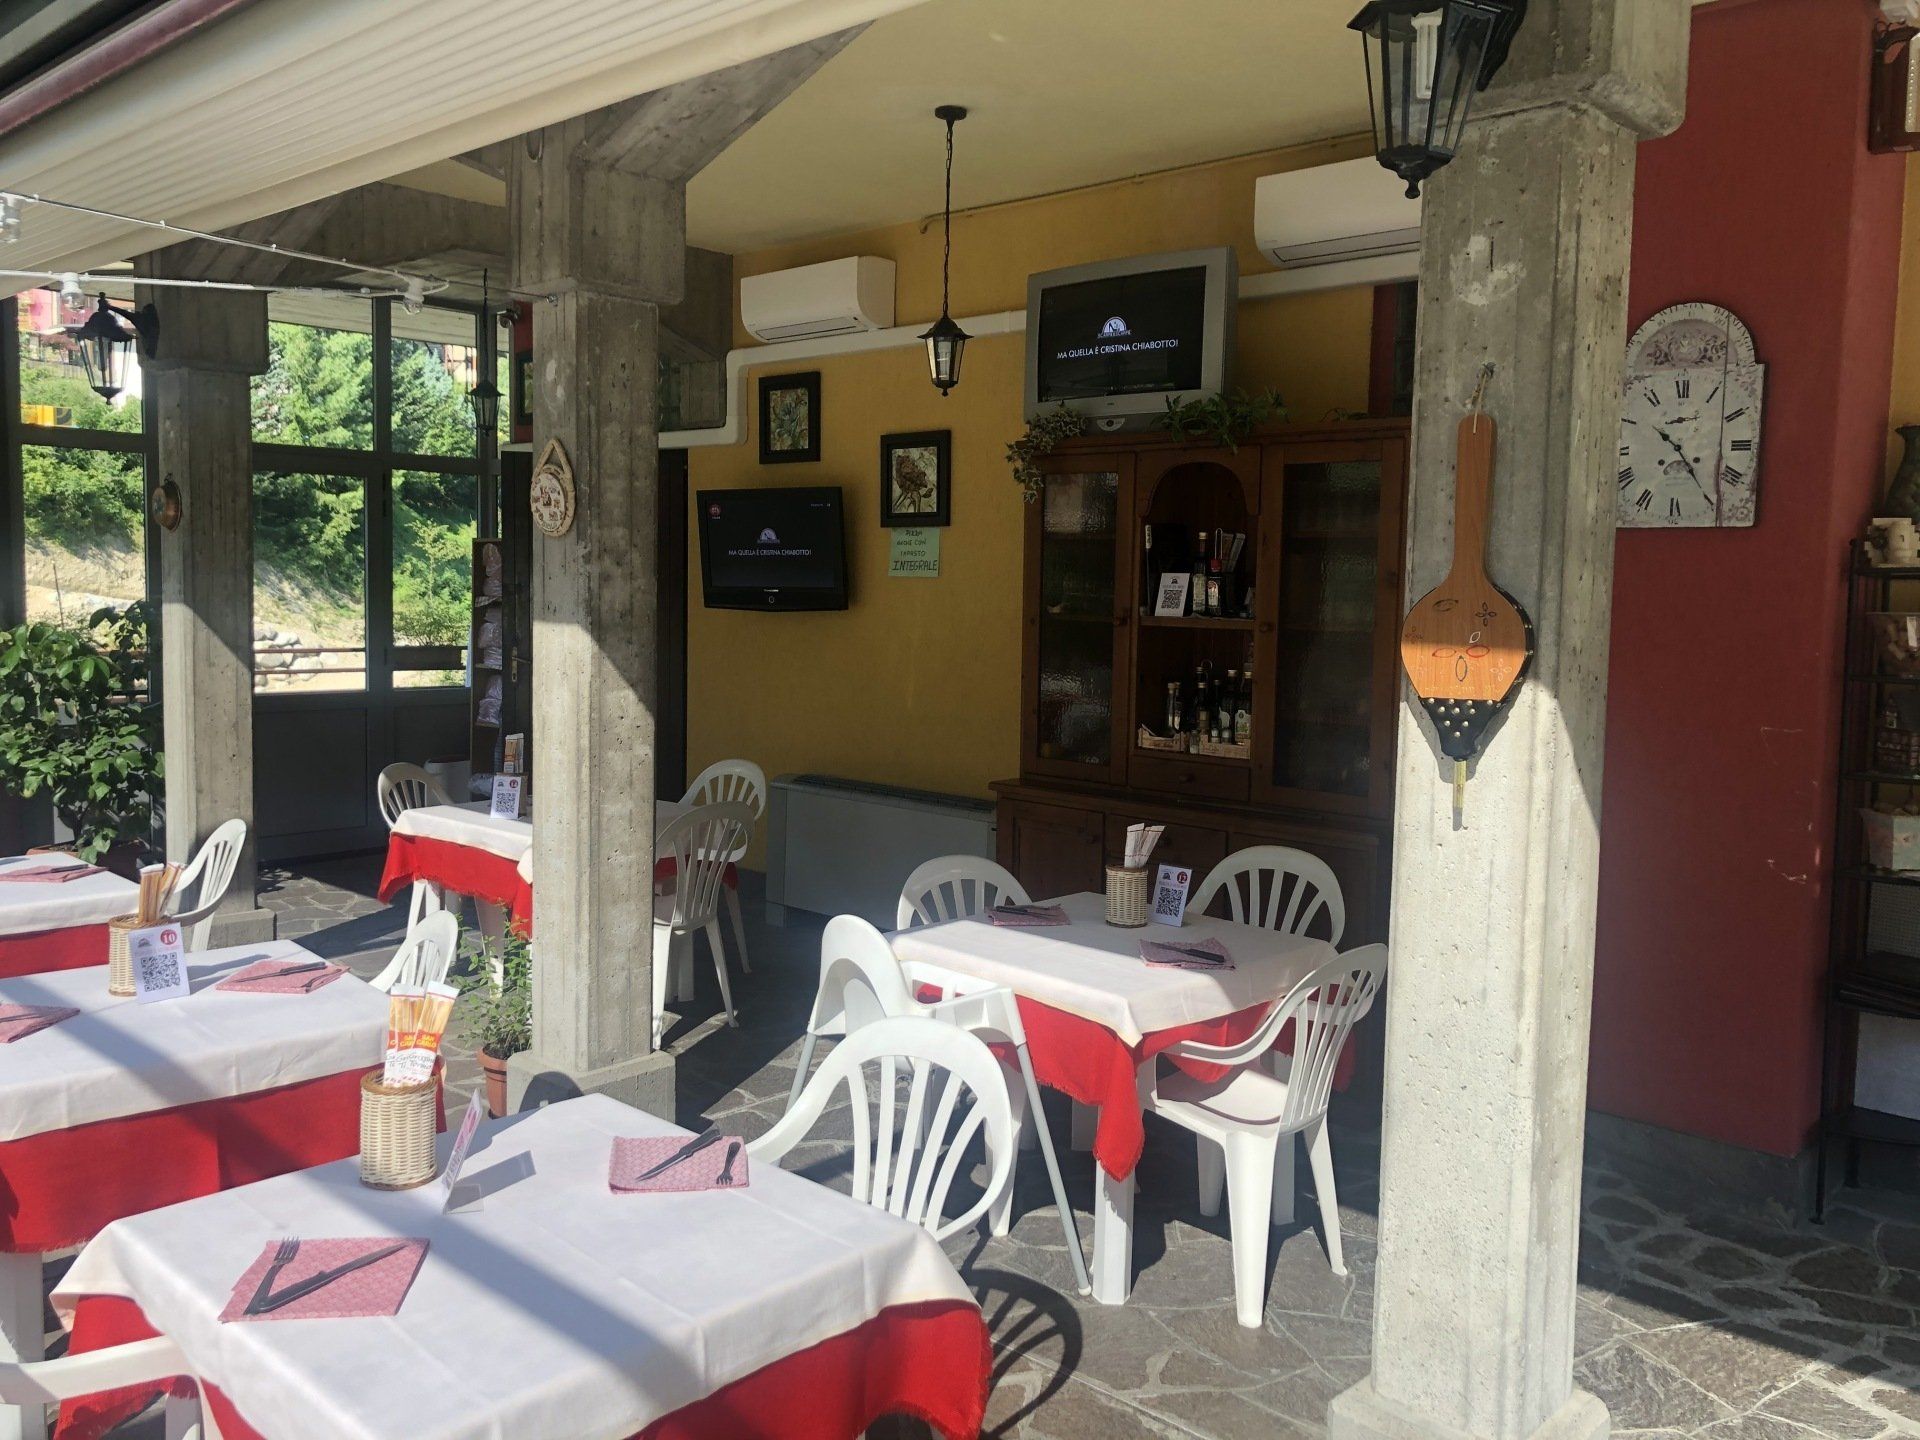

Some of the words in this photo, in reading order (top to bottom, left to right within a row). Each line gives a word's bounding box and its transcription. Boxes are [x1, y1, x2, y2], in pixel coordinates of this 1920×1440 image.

[1057, 351, 1068, 359] MA
[1068, 347, 1094, 358] QUELLA
[1100, 344, 1131, 354] CRISTINA
[892, 560, 938, 571] INTEGRALE
[163, 933, 176, 944] 10
[421, 1033, 435, 1041] SAN
[416, 1039, 437, 1048] CARLO
